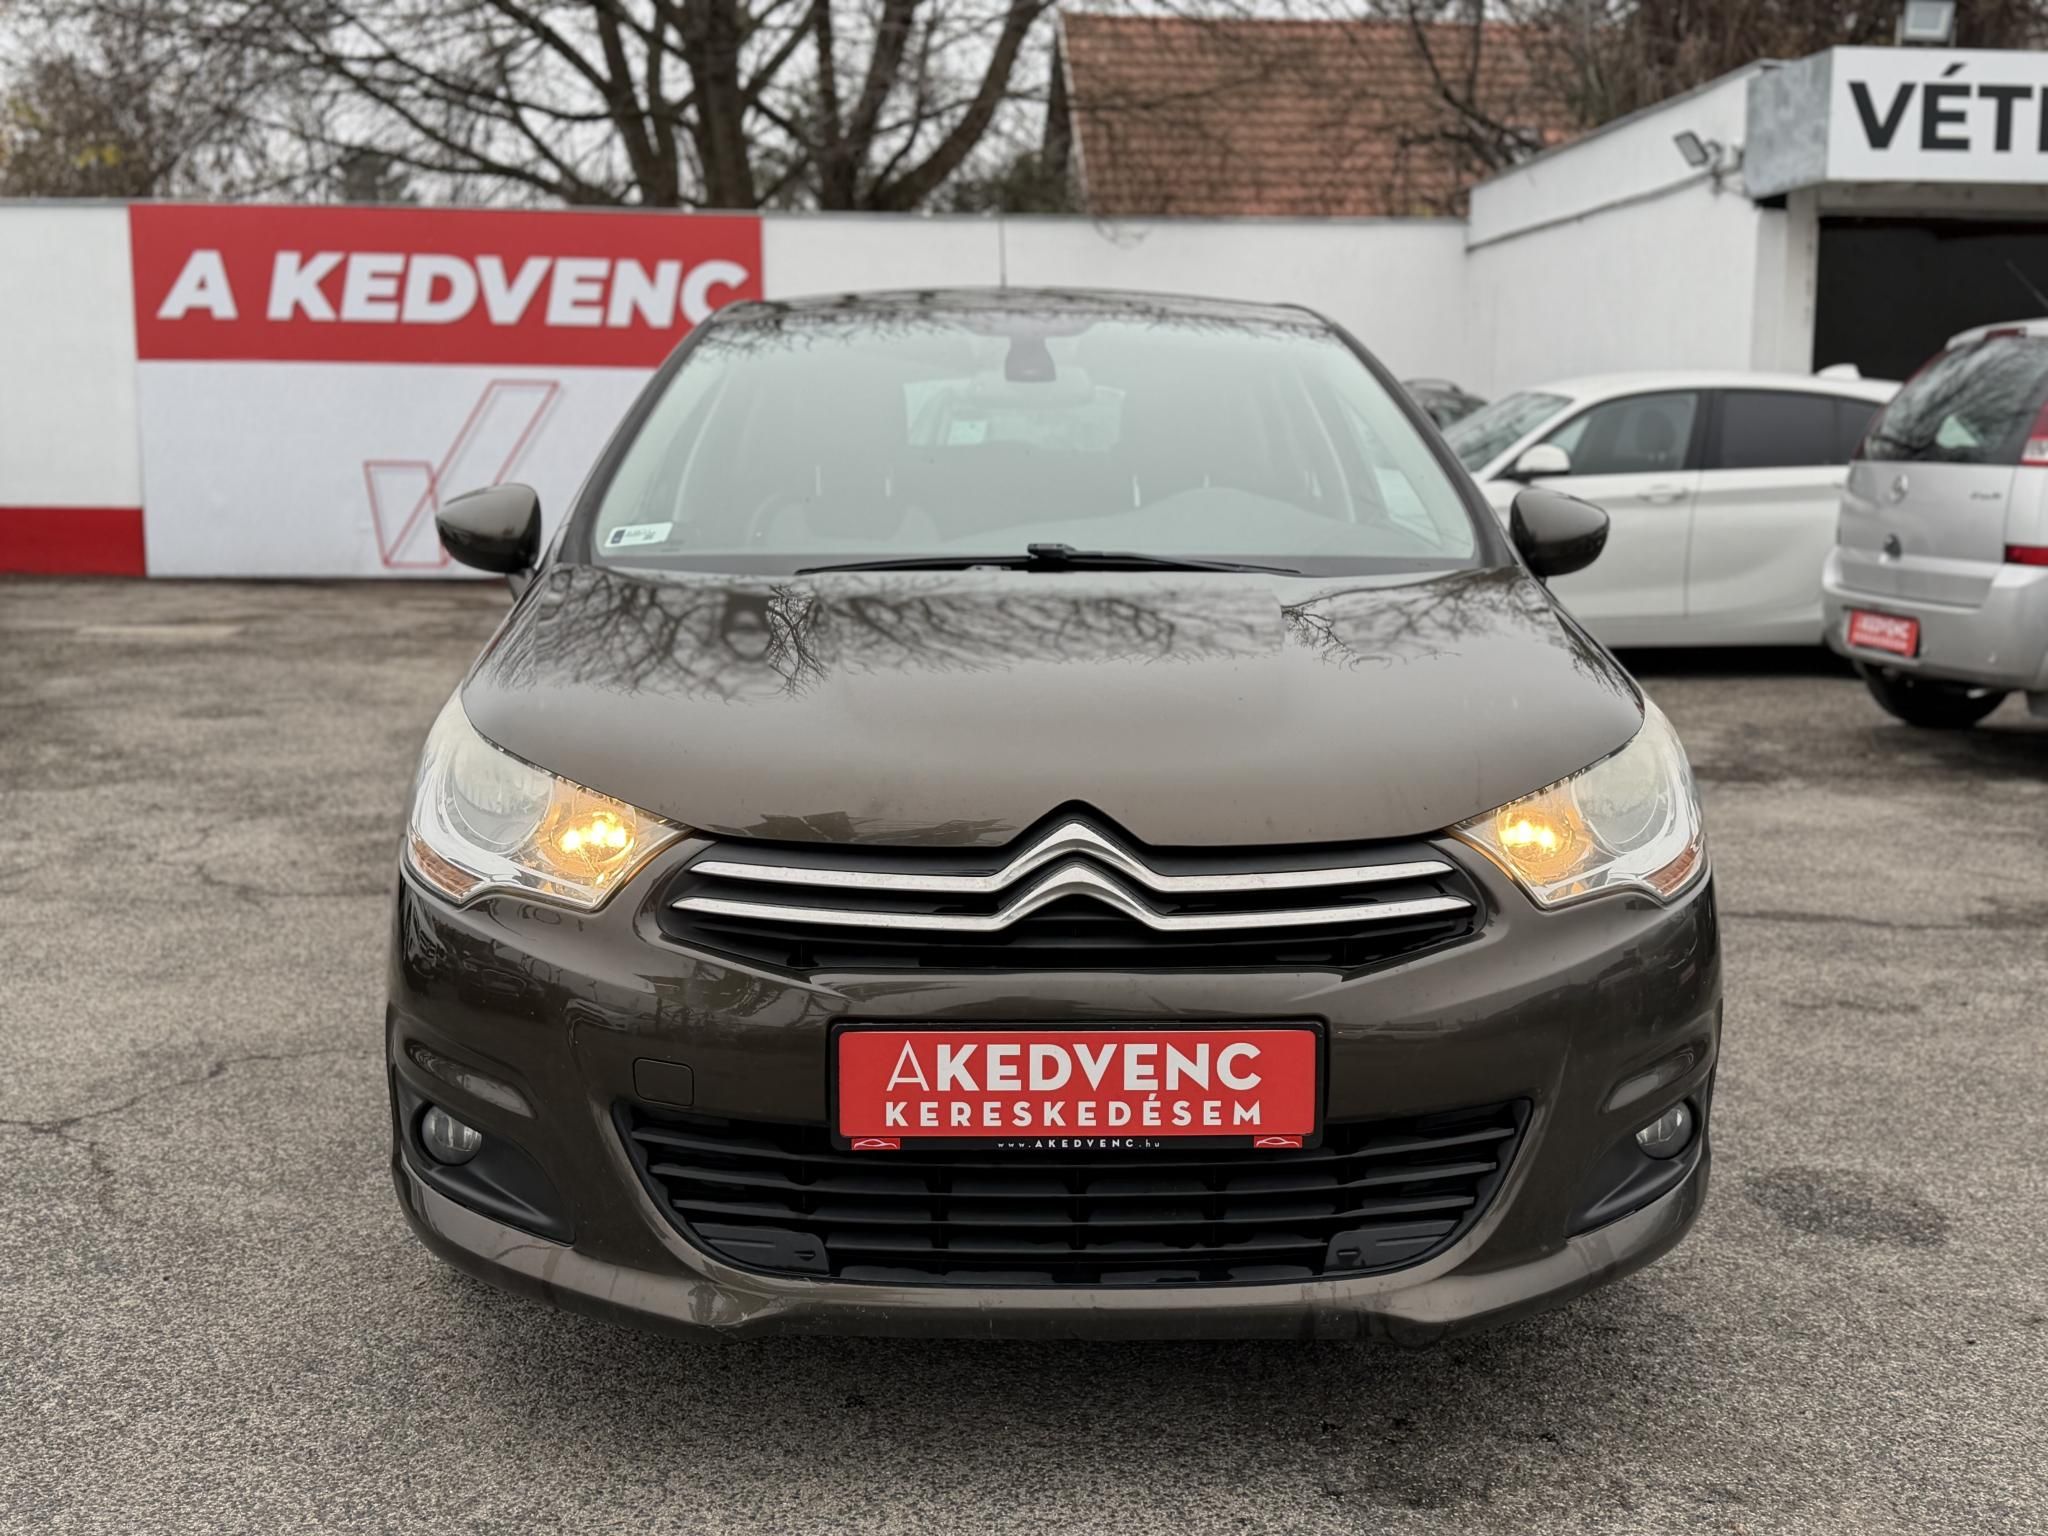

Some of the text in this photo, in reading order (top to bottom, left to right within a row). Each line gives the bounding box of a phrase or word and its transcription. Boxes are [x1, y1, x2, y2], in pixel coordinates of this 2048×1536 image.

[157, 250, 748, 328] A KEDVENC
[885, 1094, 1262, 1127] KERESKEDÉSEM
[997, 1138, 1160, 1149] www.AKEDVENC.hu
